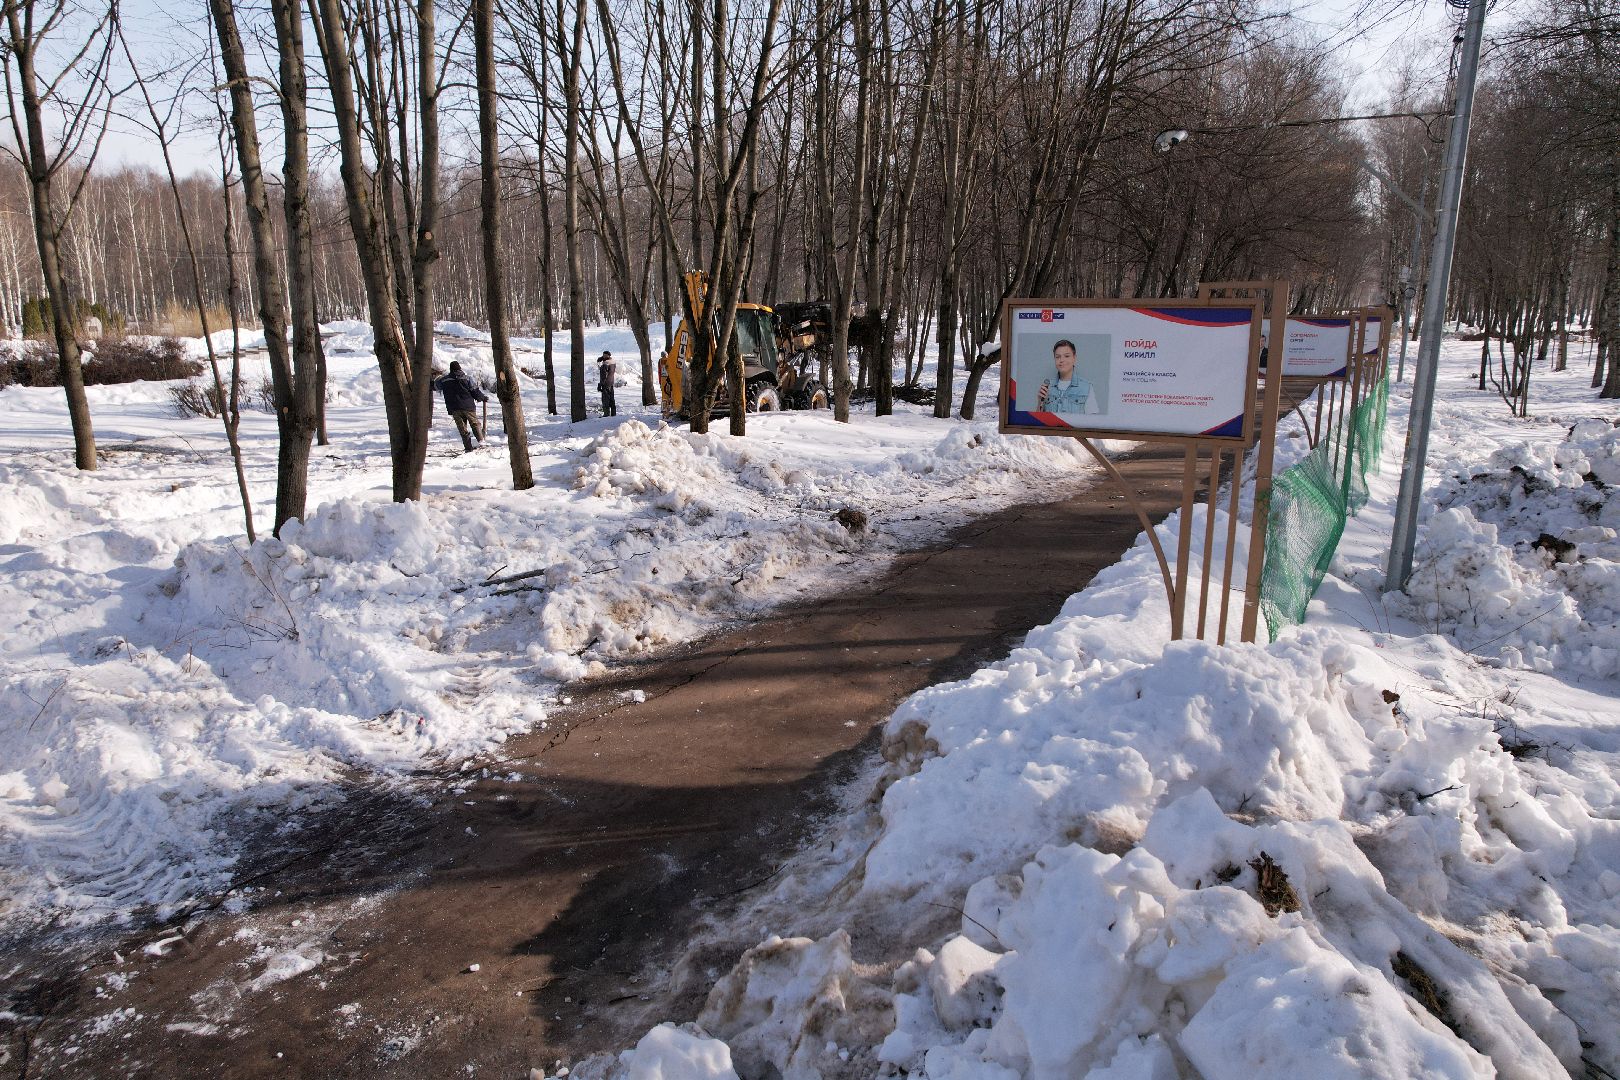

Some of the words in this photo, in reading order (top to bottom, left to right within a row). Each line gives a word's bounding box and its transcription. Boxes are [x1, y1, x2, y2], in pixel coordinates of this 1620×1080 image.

[1124, 338, 1158, 349] ПОЙДА
[677, 331, 688, 368] JCB
[1124, 351, 1156, 359] КИРИЛЛ
